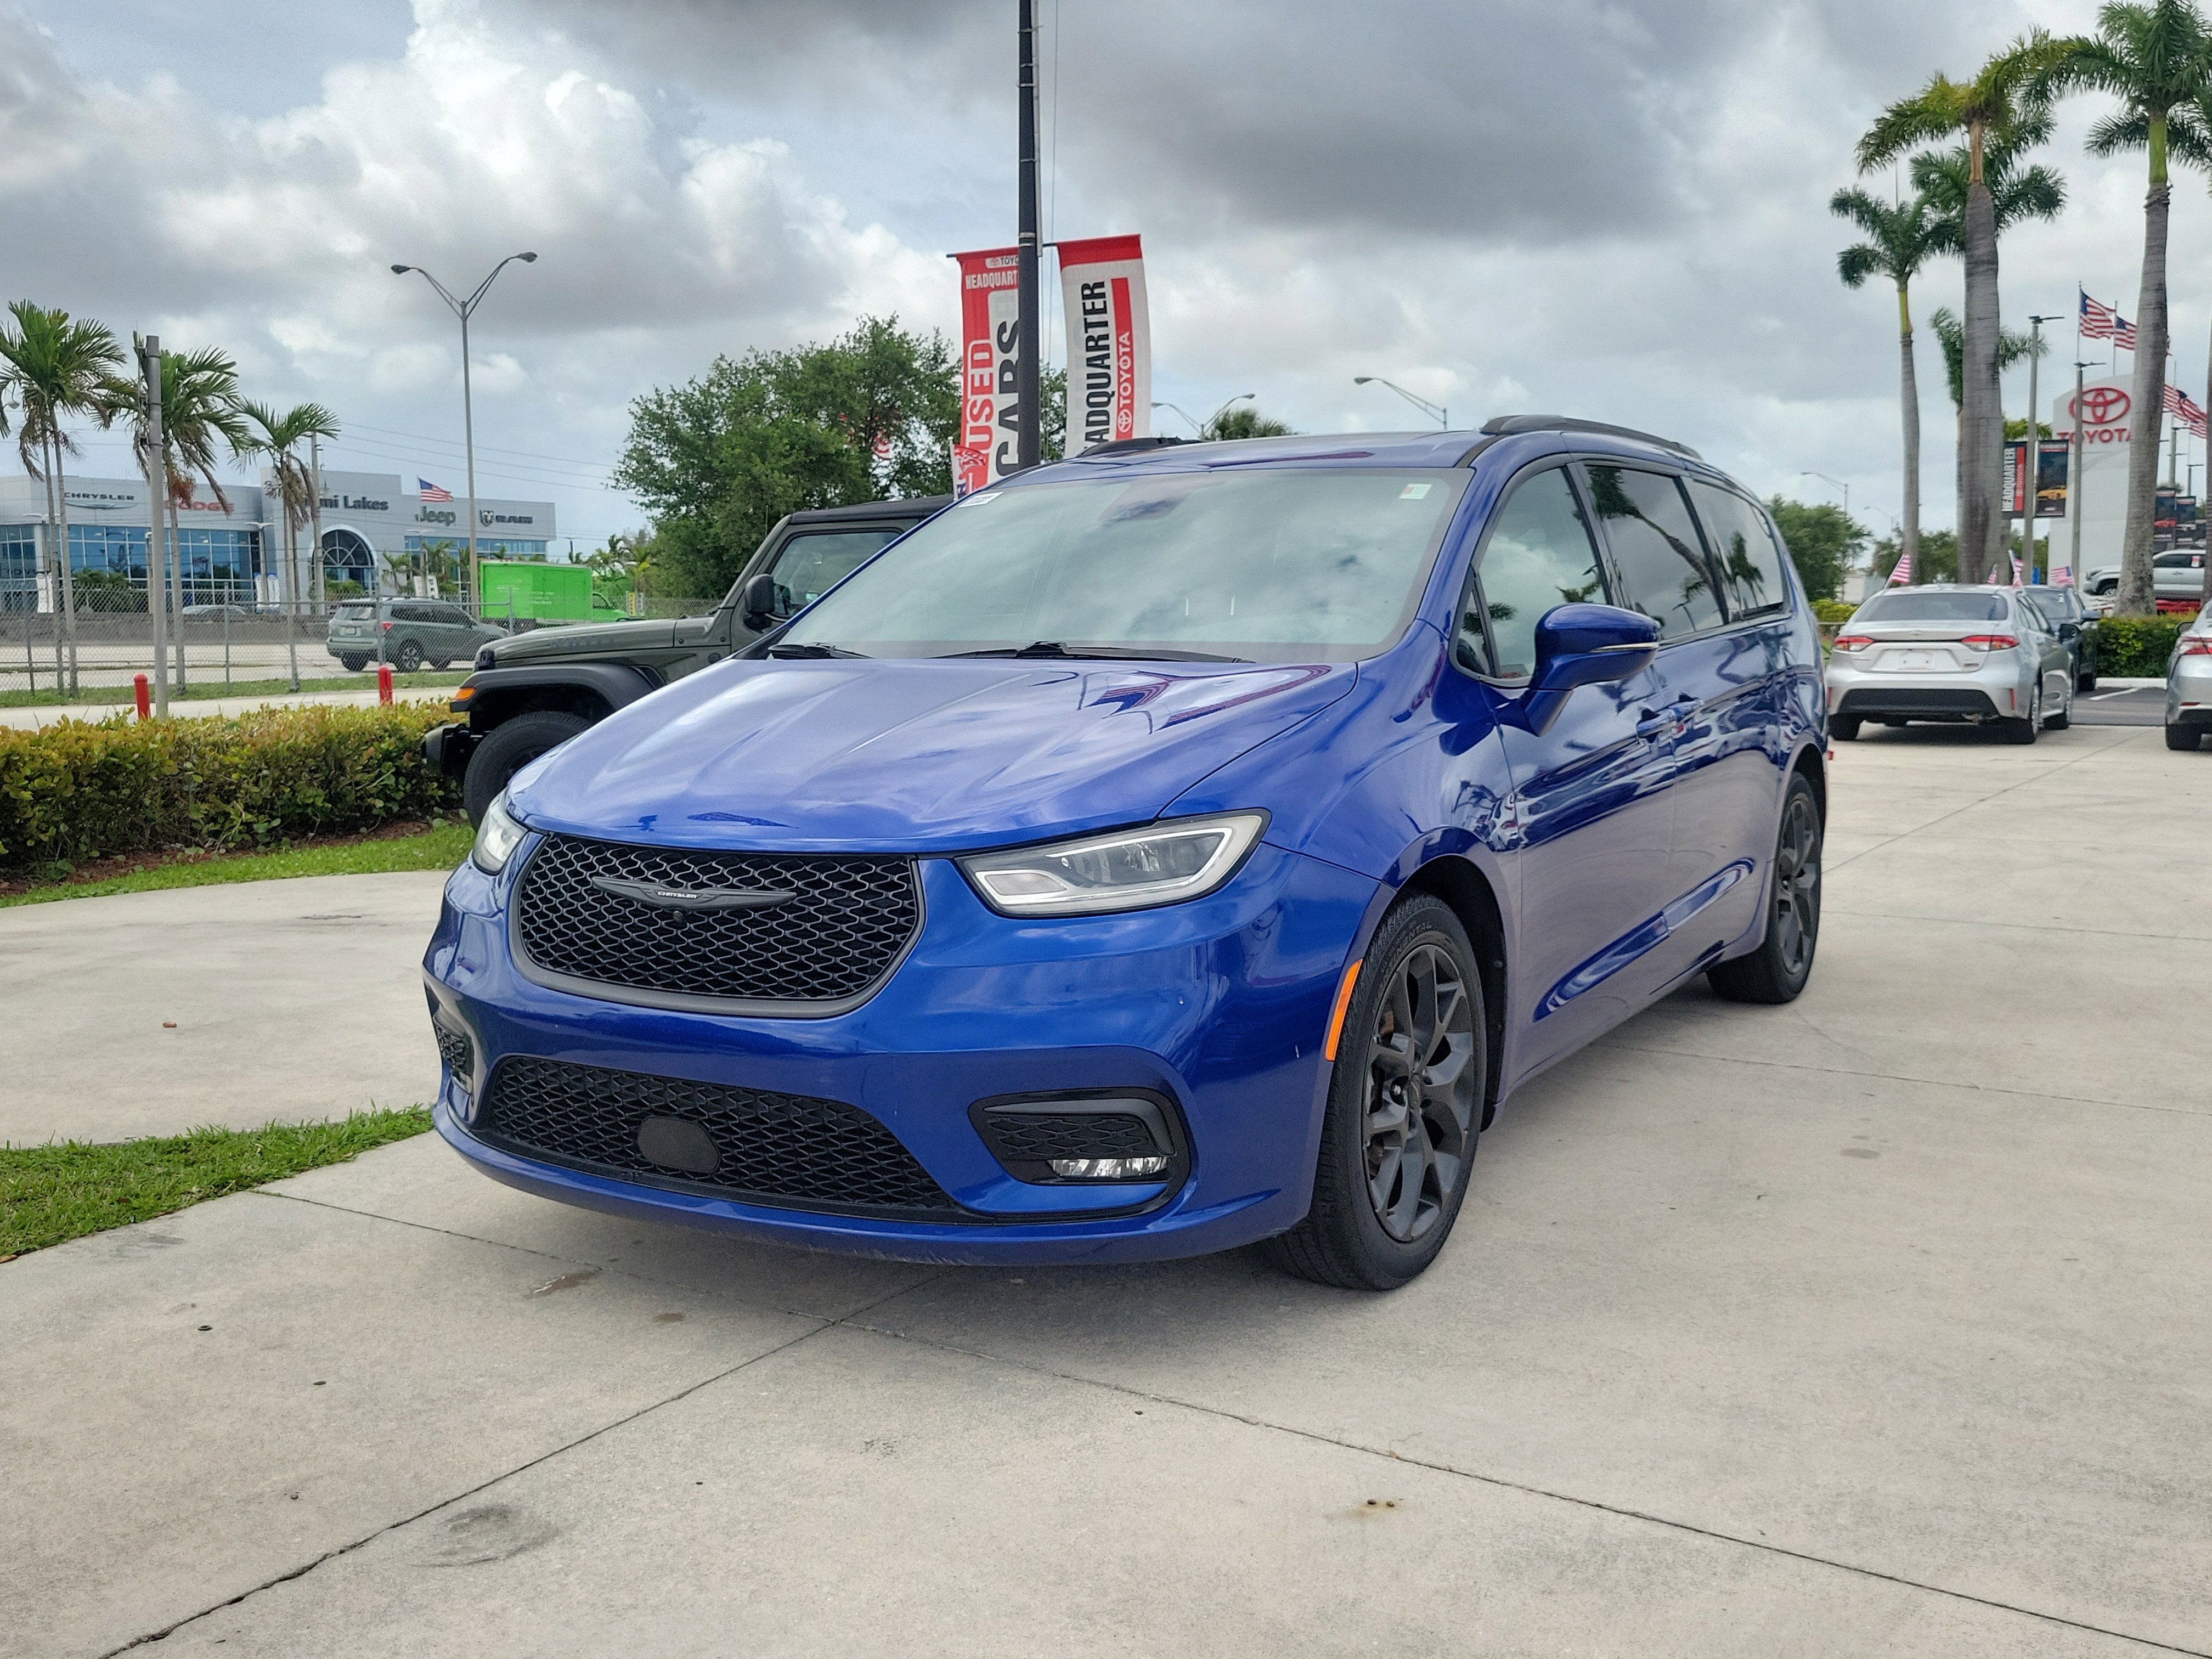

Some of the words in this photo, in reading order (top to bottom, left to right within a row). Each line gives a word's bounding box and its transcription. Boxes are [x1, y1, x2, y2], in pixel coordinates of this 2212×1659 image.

[1001, 256, 1019, 264] TOYO
[966, 269, 1018, 290] HEADQUART
[1081, 281, 1115, 445] ADQUARTER
[1119, 331, 1132, 408] TOYOTA
[969, 342, 994, 452] USED
[343, 495, 389, 510] Lakes
[415, 506, 456, 527] Jeep
